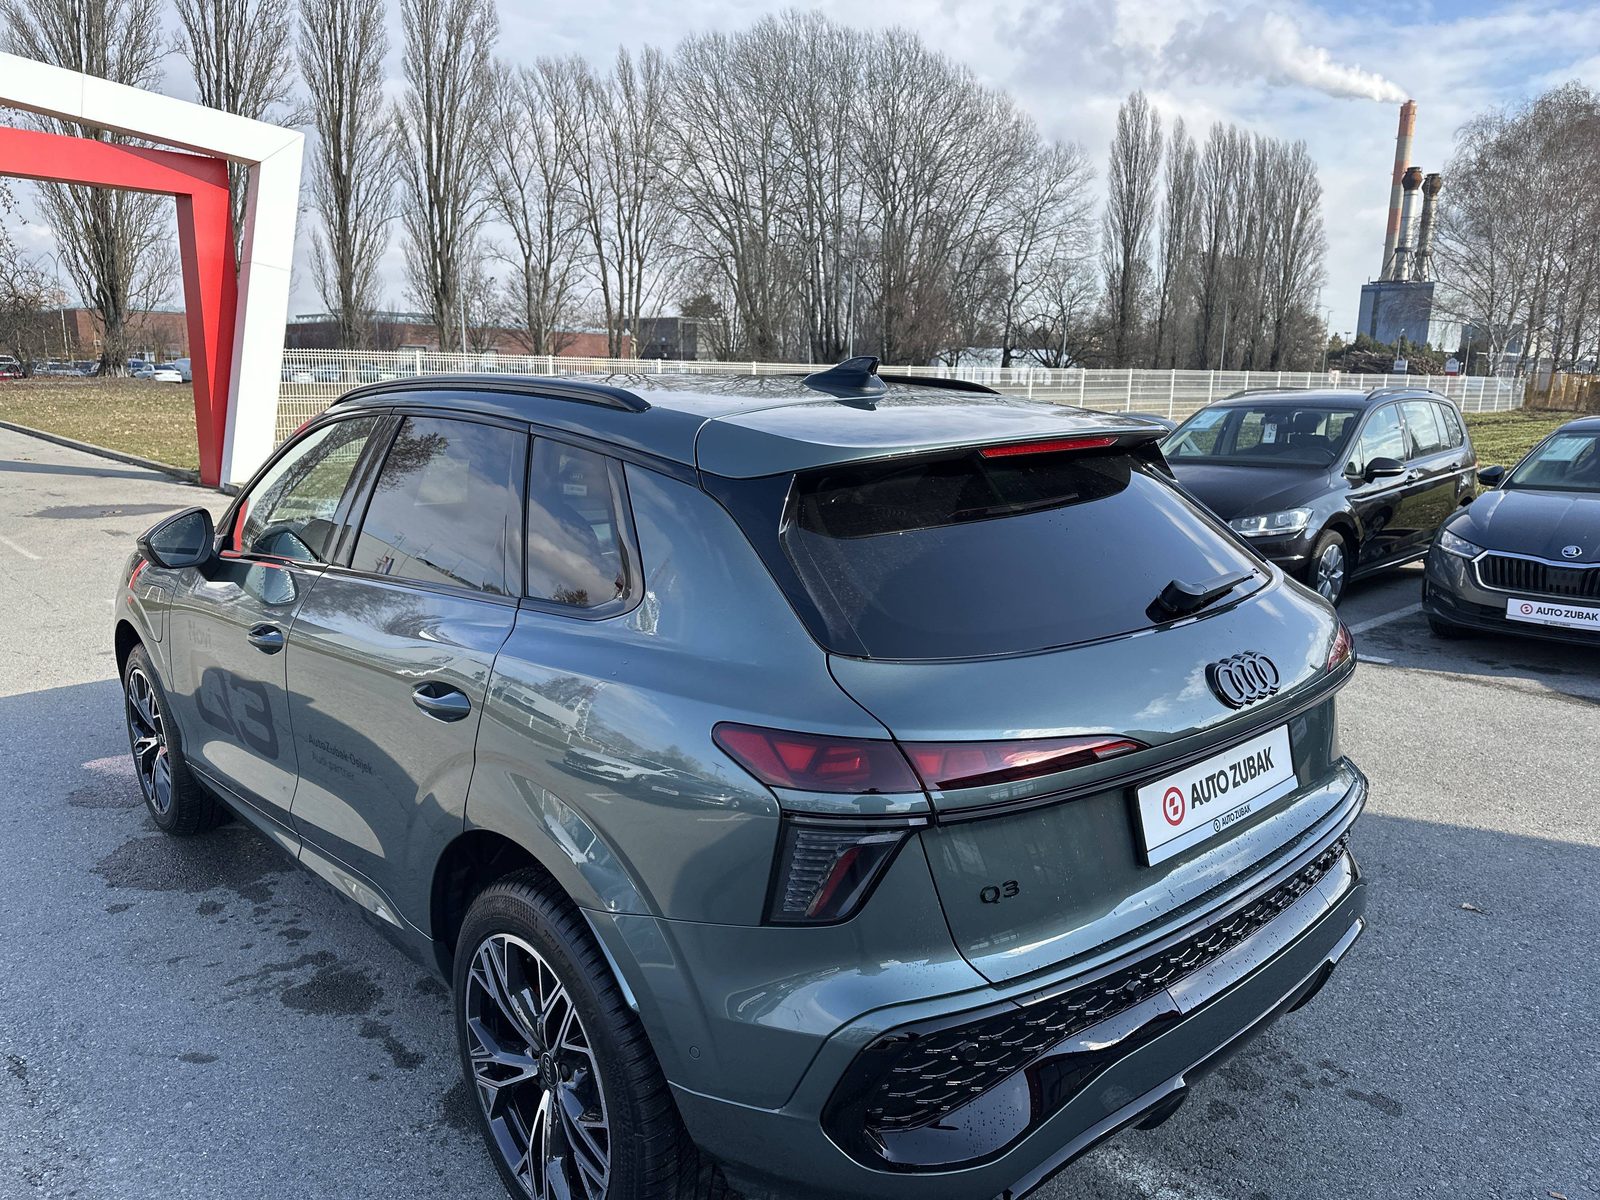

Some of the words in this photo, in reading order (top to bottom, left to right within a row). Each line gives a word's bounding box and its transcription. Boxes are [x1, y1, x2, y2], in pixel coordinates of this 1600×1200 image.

[1535, 606, 1563, 617] AUTO
[1563, 609, 1599, 621] ZUBAK
[1191, 769, 1229, 809] AUTO
[1229, 746, 1275, 789] ZUBAK
[1221, 812, 1235, 827] AUTO
[1235, 803, 1252, 820] ZUBAK
[980, 880, 1020, 904] Q3
